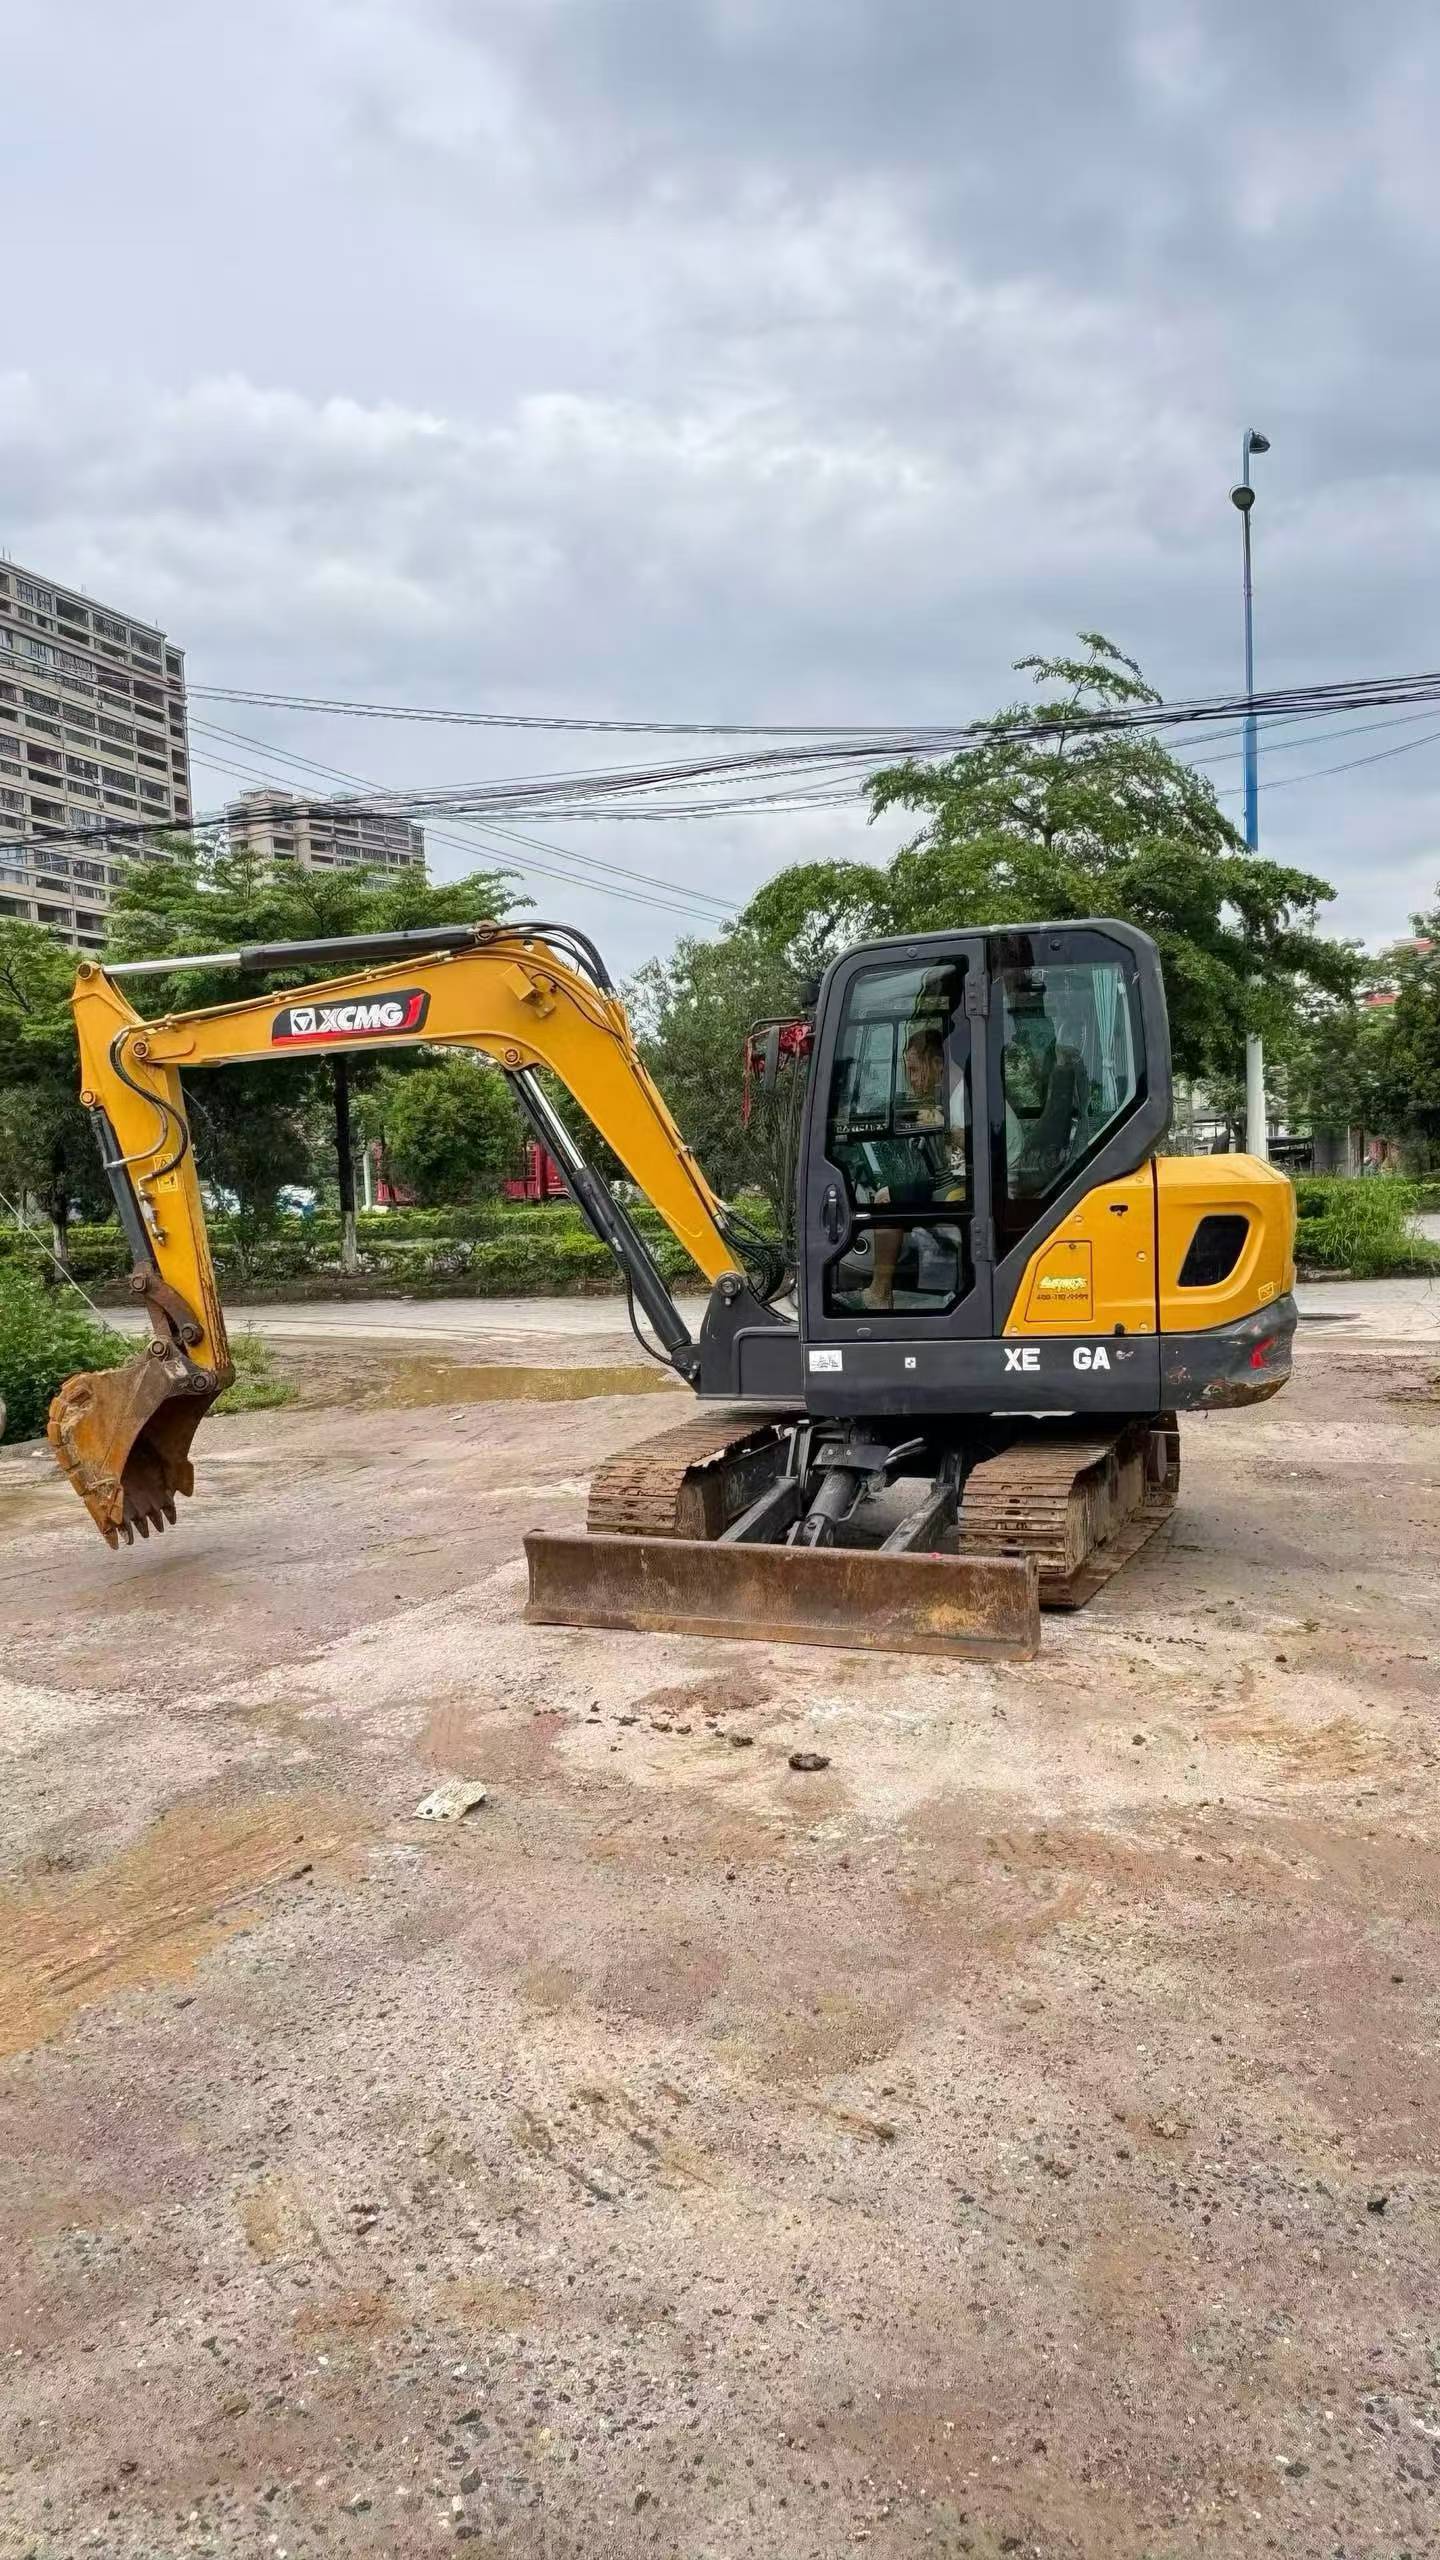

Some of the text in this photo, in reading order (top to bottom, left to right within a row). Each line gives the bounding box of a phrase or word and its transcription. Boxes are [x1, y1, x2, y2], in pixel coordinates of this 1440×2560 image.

[317, 1002, 404, 1032] XCMG
[1004, 1346, 1111, 1371] XE GA
